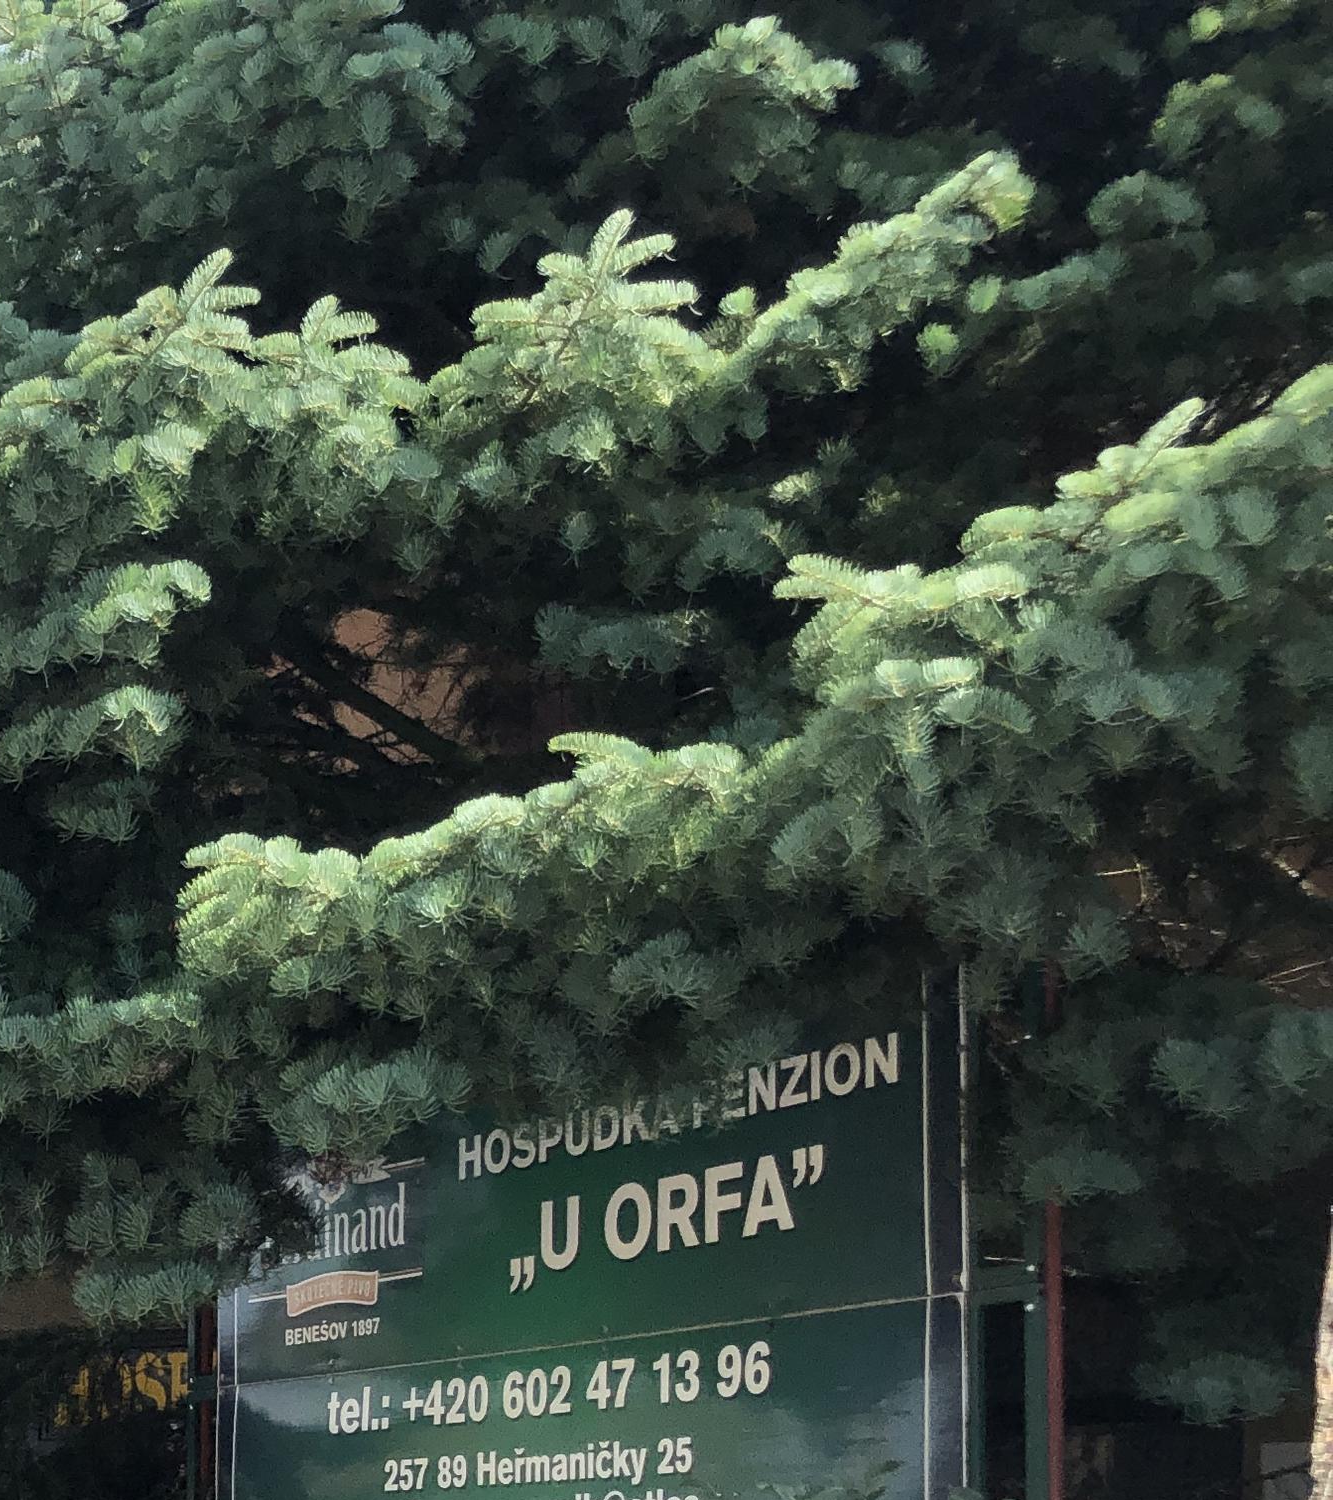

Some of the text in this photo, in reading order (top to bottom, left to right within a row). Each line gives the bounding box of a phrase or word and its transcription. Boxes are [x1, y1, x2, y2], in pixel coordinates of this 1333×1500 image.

[285, 1317, 381, 1346] BENEŠOV 1897
[327, 1340, 771, 1434] tel.: +420 602 47 13 96
[383, 1435, 693, 1492] 257 89 Heřmaničky 25
